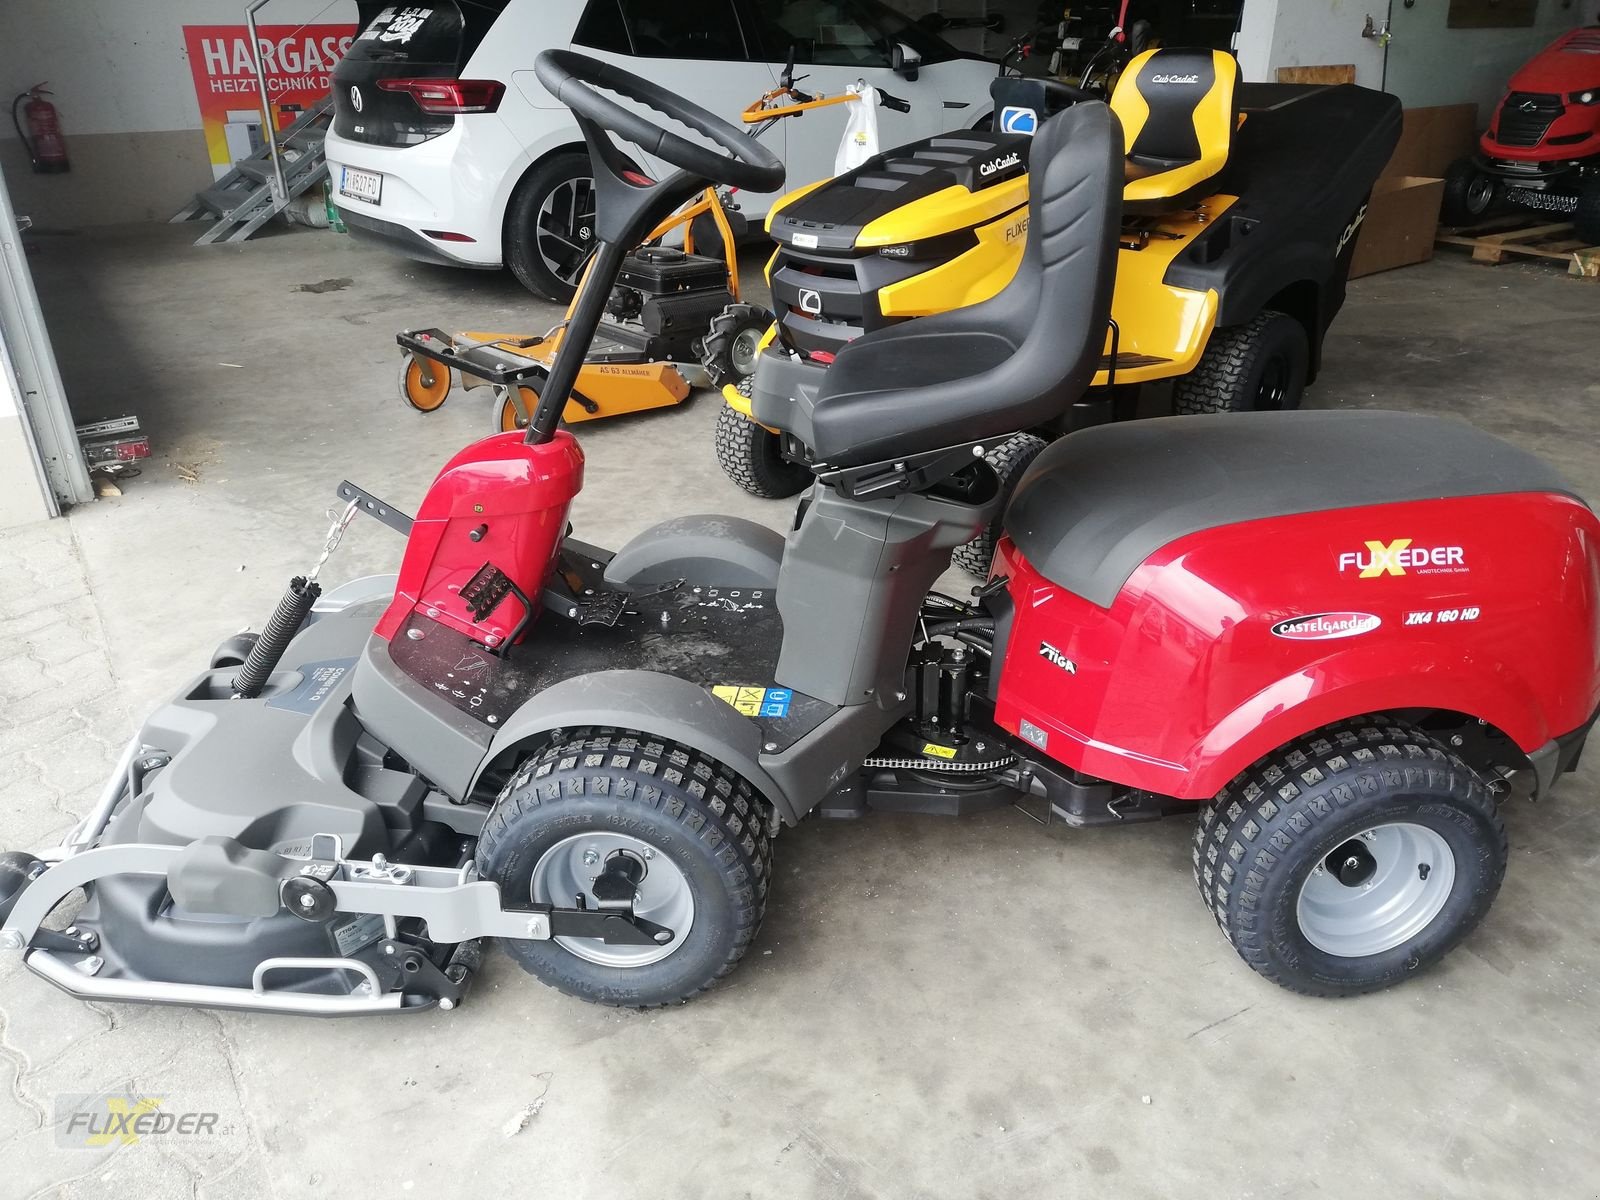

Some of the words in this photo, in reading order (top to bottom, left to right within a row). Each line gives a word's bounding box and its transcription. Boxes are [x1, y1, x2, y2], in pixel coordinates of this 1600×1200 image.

[980, 161, 997, 176] Cub
[995, 152, 1022, 170] Cadet
[600, 366, 609, 374] AS
[610, 367, 620, 375] 63
[1405, 612, 1433, 626] XK4
[1436, 609, 1457, 623] 160
[1460, 607, 1480, 621] HD
